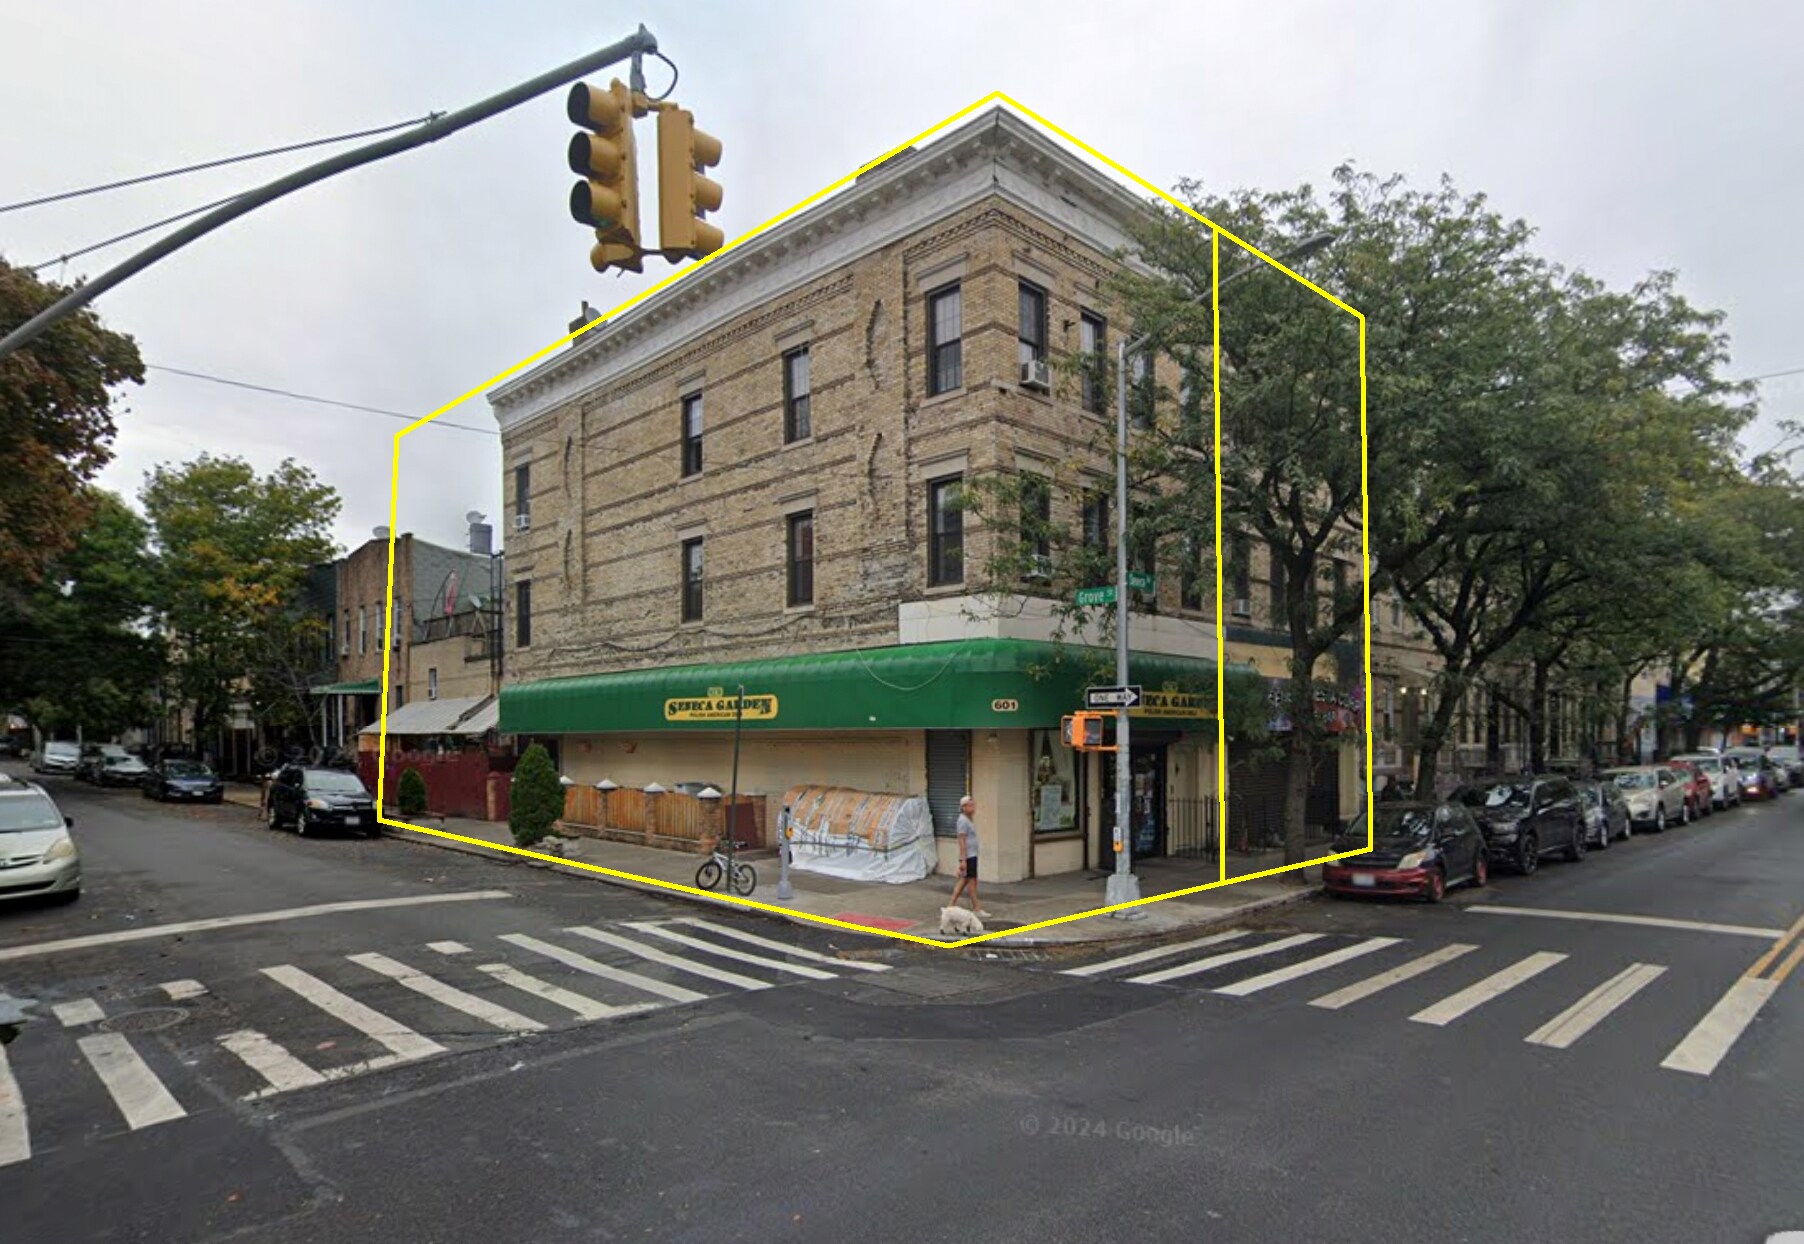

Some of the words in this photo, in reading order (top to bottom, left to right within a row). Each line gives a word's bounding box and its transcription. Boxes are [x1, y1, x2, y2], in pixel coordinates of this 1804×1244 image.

[1079, 590, 1105, 603] Grove
[1093, 694, 1109, 703] ONE
[1116, 693, 1134, 702] WAY
[994, 701, 1016, 710] 601
